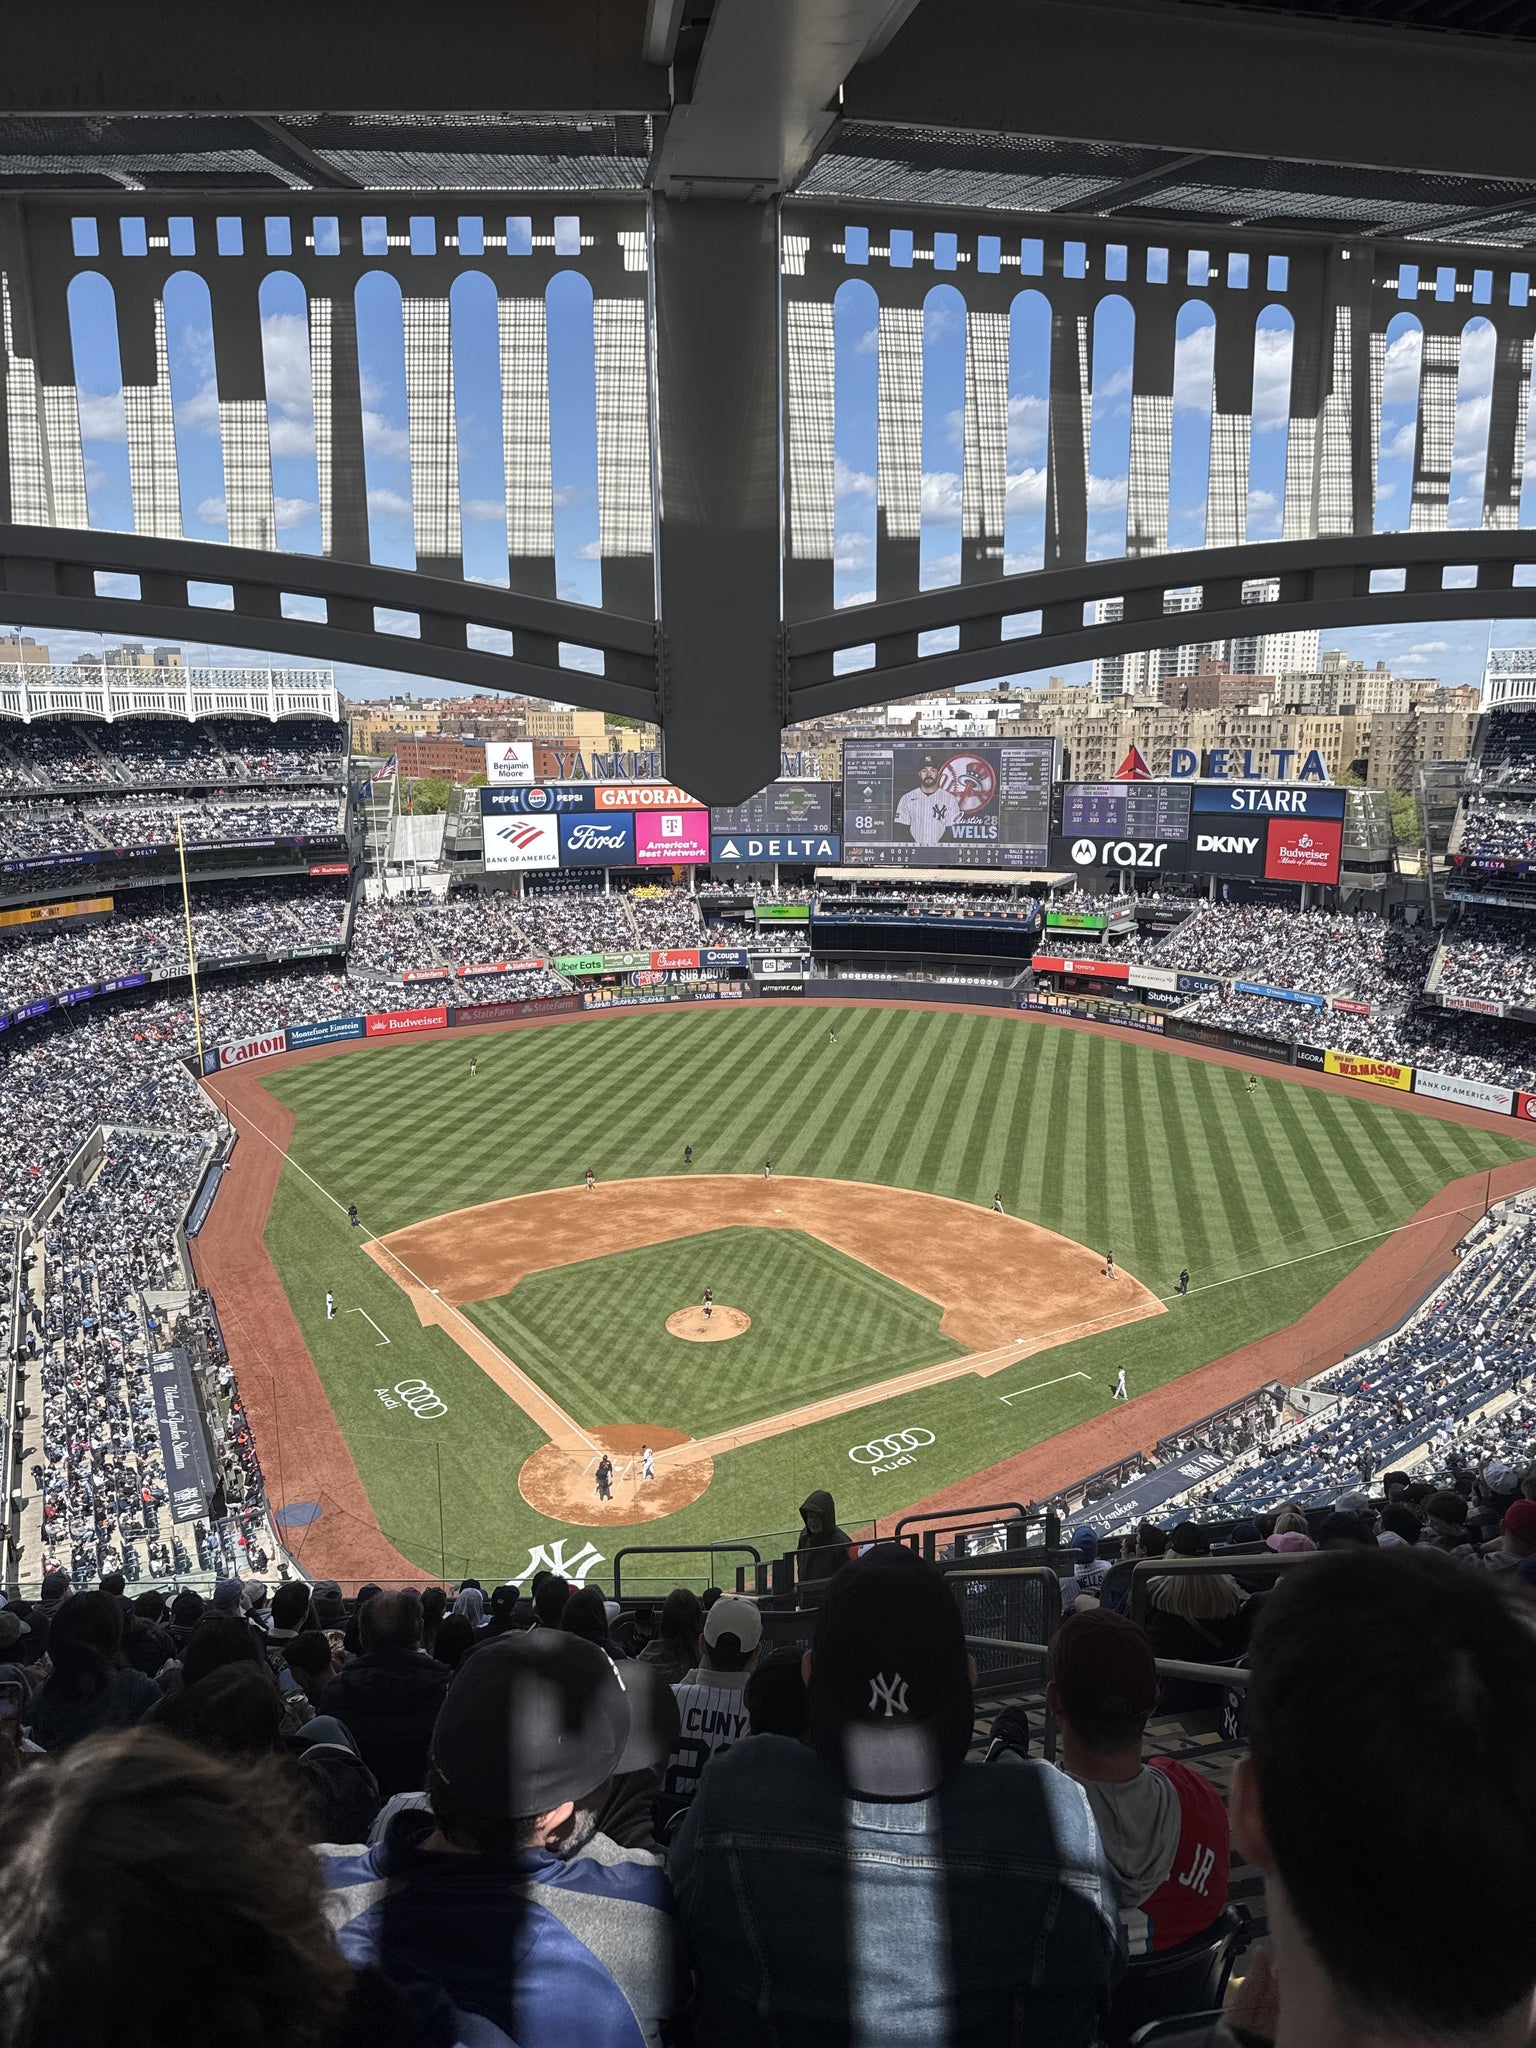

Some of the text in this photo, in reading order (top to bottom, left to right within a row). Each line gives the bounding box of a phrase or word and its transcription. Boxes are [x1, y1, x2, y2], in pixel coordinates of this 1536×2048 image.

[493, 762, 529, 771] Benjamin
[1170, 749, 1329, 781] DELTA
[492, 795, 519, 804] PEPSI
[556, 794, 583, 803] PEPSI
[601, 789, 700, 806] GATORAD
[1230, 788, 1307, 813] STARR
[855, 816, 873, 828] 88
[952, 811, 998, 826] Austin 28
[567, 824, 627, 850] Ford
[952, 825, 998, 839] WELLS
[646, 840, 698, 849] America's
[748, 839, 833, 856] DELTA
[1196, 835, 1260, 854] DKNY
[486, 856, 507, 864] BANK
[521, 854, 557, 862] AMERICA
[638, 848, 707, 858] Best Network
[879, 851, 885, 859] 4
[1101, 841, 1168, 868] razr
[1279, 846, 1330, 860] Budweiser
[1277, 856, 1297, 865] Made
[1302, 859, 1328, 867] America
[1478, 860, 1505, 869] DELTA
[716, 952, 740, 961] coupa
[159, 965, 189, 979] ORIS
[580, 961, 602, 970] Eats
[764, 961, 775, 969] GS
[671, 967, 730, 982] A SUB ABOVE
[1193, 982, 1219, 990] CLEAR
[586, 1001, 611, 1009] StubHub
[612, 998, 638, 1006] StubHub
[639, 996, 665, 1004] StubHub
[1147, 991, 1181, 1004] StubHub
[1445, 997, 1499, 1013] Parts Authority
[1051, 1006, 1072, 1016] STARR
[388, 1015, 444, 1030] Budweiser
[1109, 1017, 1164, 1034] StubHub StubHub StubHub
[291, 1027, 329, 1040] Montefiore
[329, 1022, 359, 1033] Einstein
[1178, 1024, 1219, 1043] freshdirect
[220, 1035, 285, 1065] Canon
[1246, 1041, 1268, 1052] freshest
[1268, 1047, 1287, 1057] grocer
[1297, 1051, 1324, 1064] LEGORA
[1339, 1062, 1402, 1080] W.B.MASON
[1417, 1079, 1491, 1101] BANK OF AMERICA
[163, 1384, 178, 1411] Welcome
[373, 1388, 402, 1410] Audi
[160, 1416, 187, 1441] Yankee
[172, 1440, 190, 1470] Stadium
[871, 1454, 917, 1476] Audi
[1097, 1500, 1139, 1530] Yankees
[504, 1538, 607, 1590] NY
[868, 1672, 910, 1717] NY
[686, 1707, 748, 1739] CUNY
[1178, 1843, 1216, 1897] JR.
